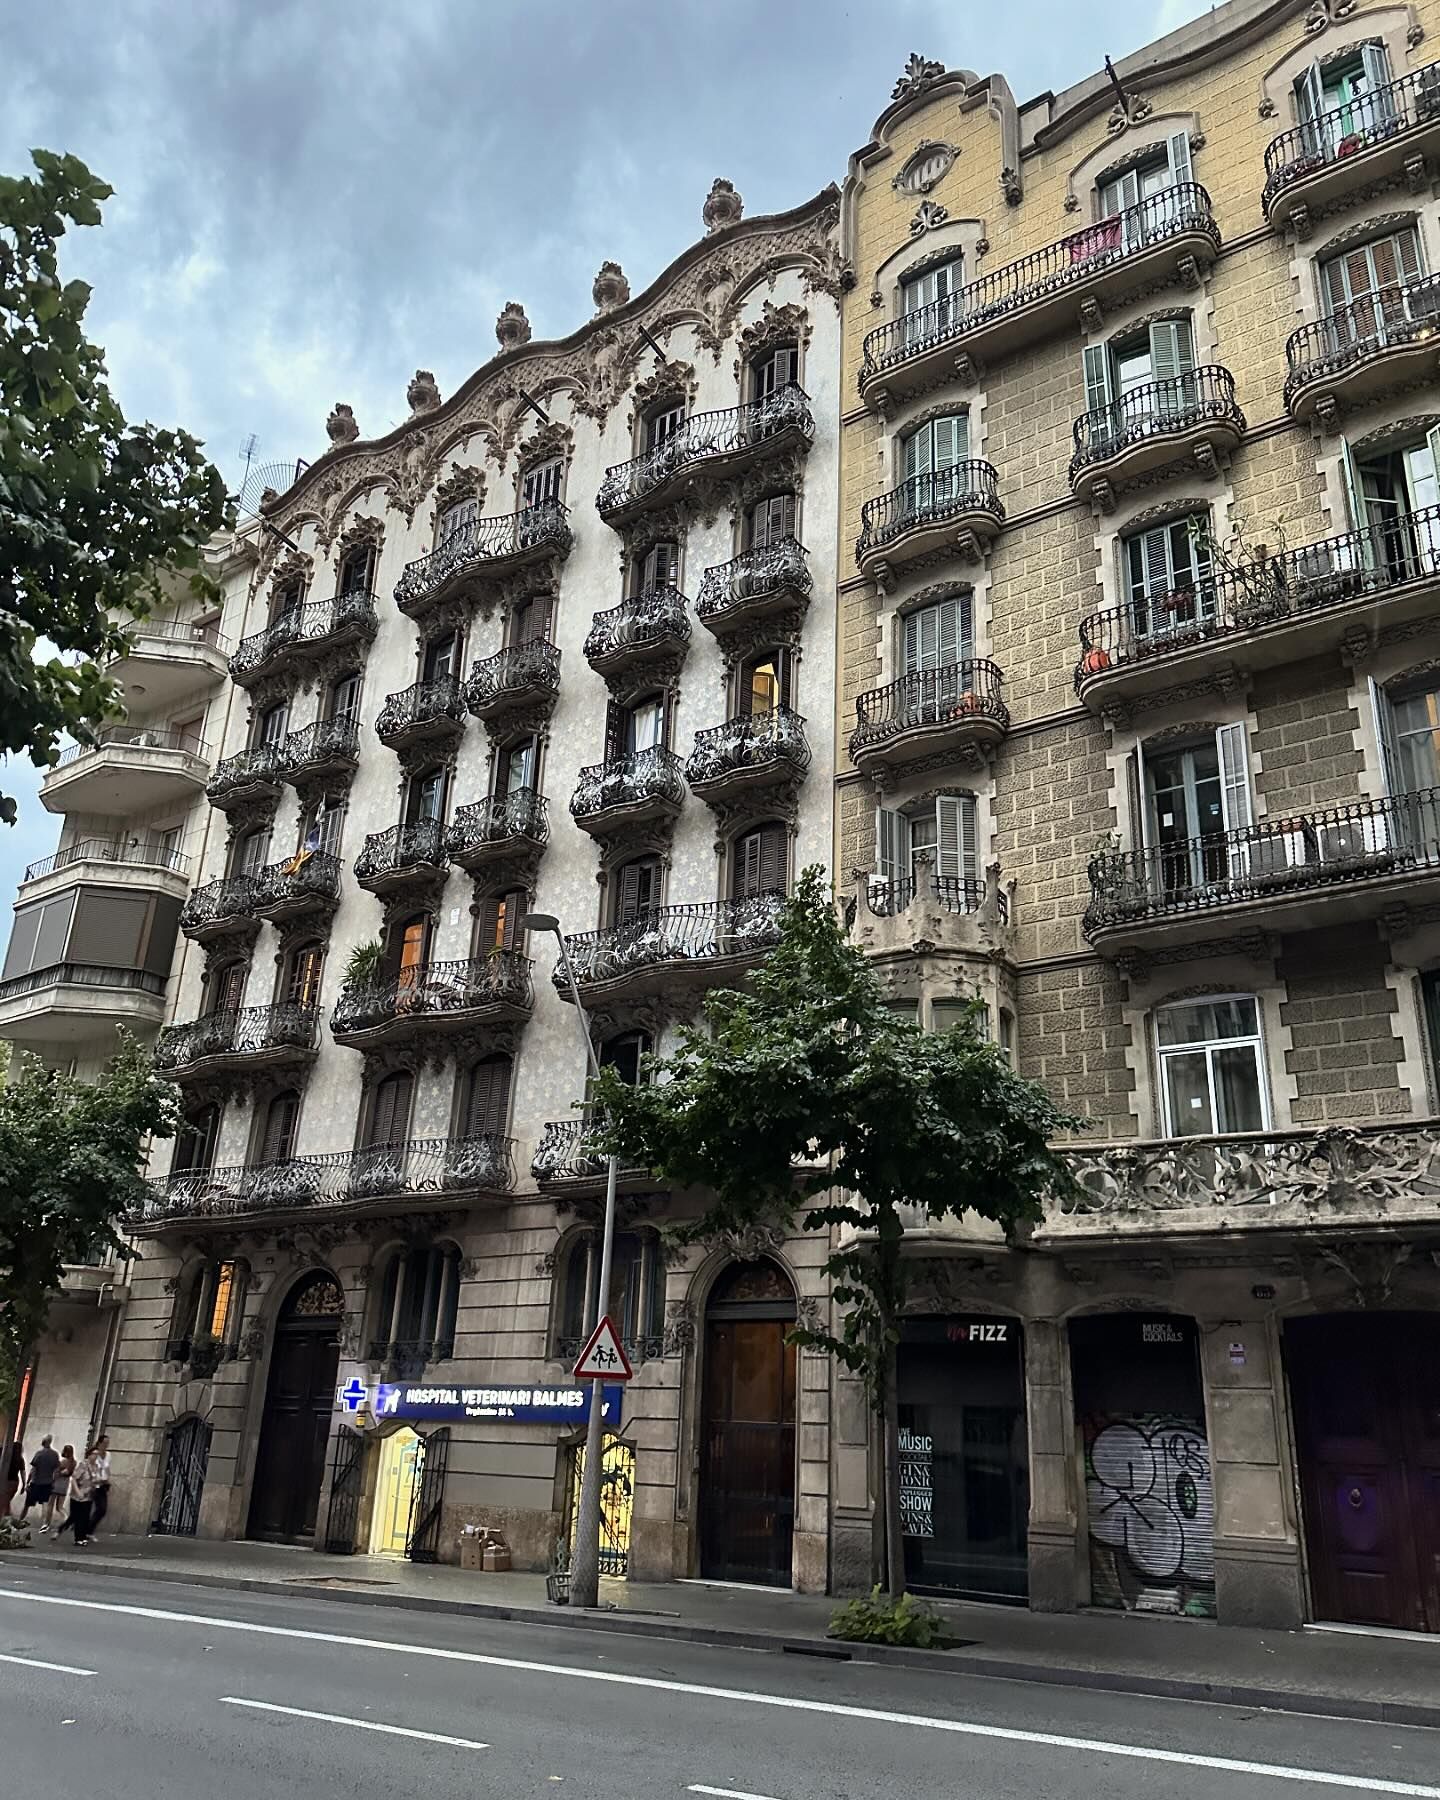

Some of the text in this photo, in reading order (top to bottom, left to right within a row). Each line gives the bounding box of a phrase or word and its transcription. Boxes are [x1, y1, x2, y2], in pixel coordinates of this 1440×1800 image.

[969, 1325, 1007, 1341] FIZZ
[1142, 1323, 1166, 1333] MUSIC
[1143, 1331, 1184, 1342] COCKTAILS
[406, 1389, 583, 1407] HOSPITAL VETERINARI BALMES
[898, 1427, 911, 1436] LIVE
[898, 1435, 933, 1451] MUSIC
[899, 1475, 934, 1488] TONIC
[899, 1495, 933, 1512] SHOW
